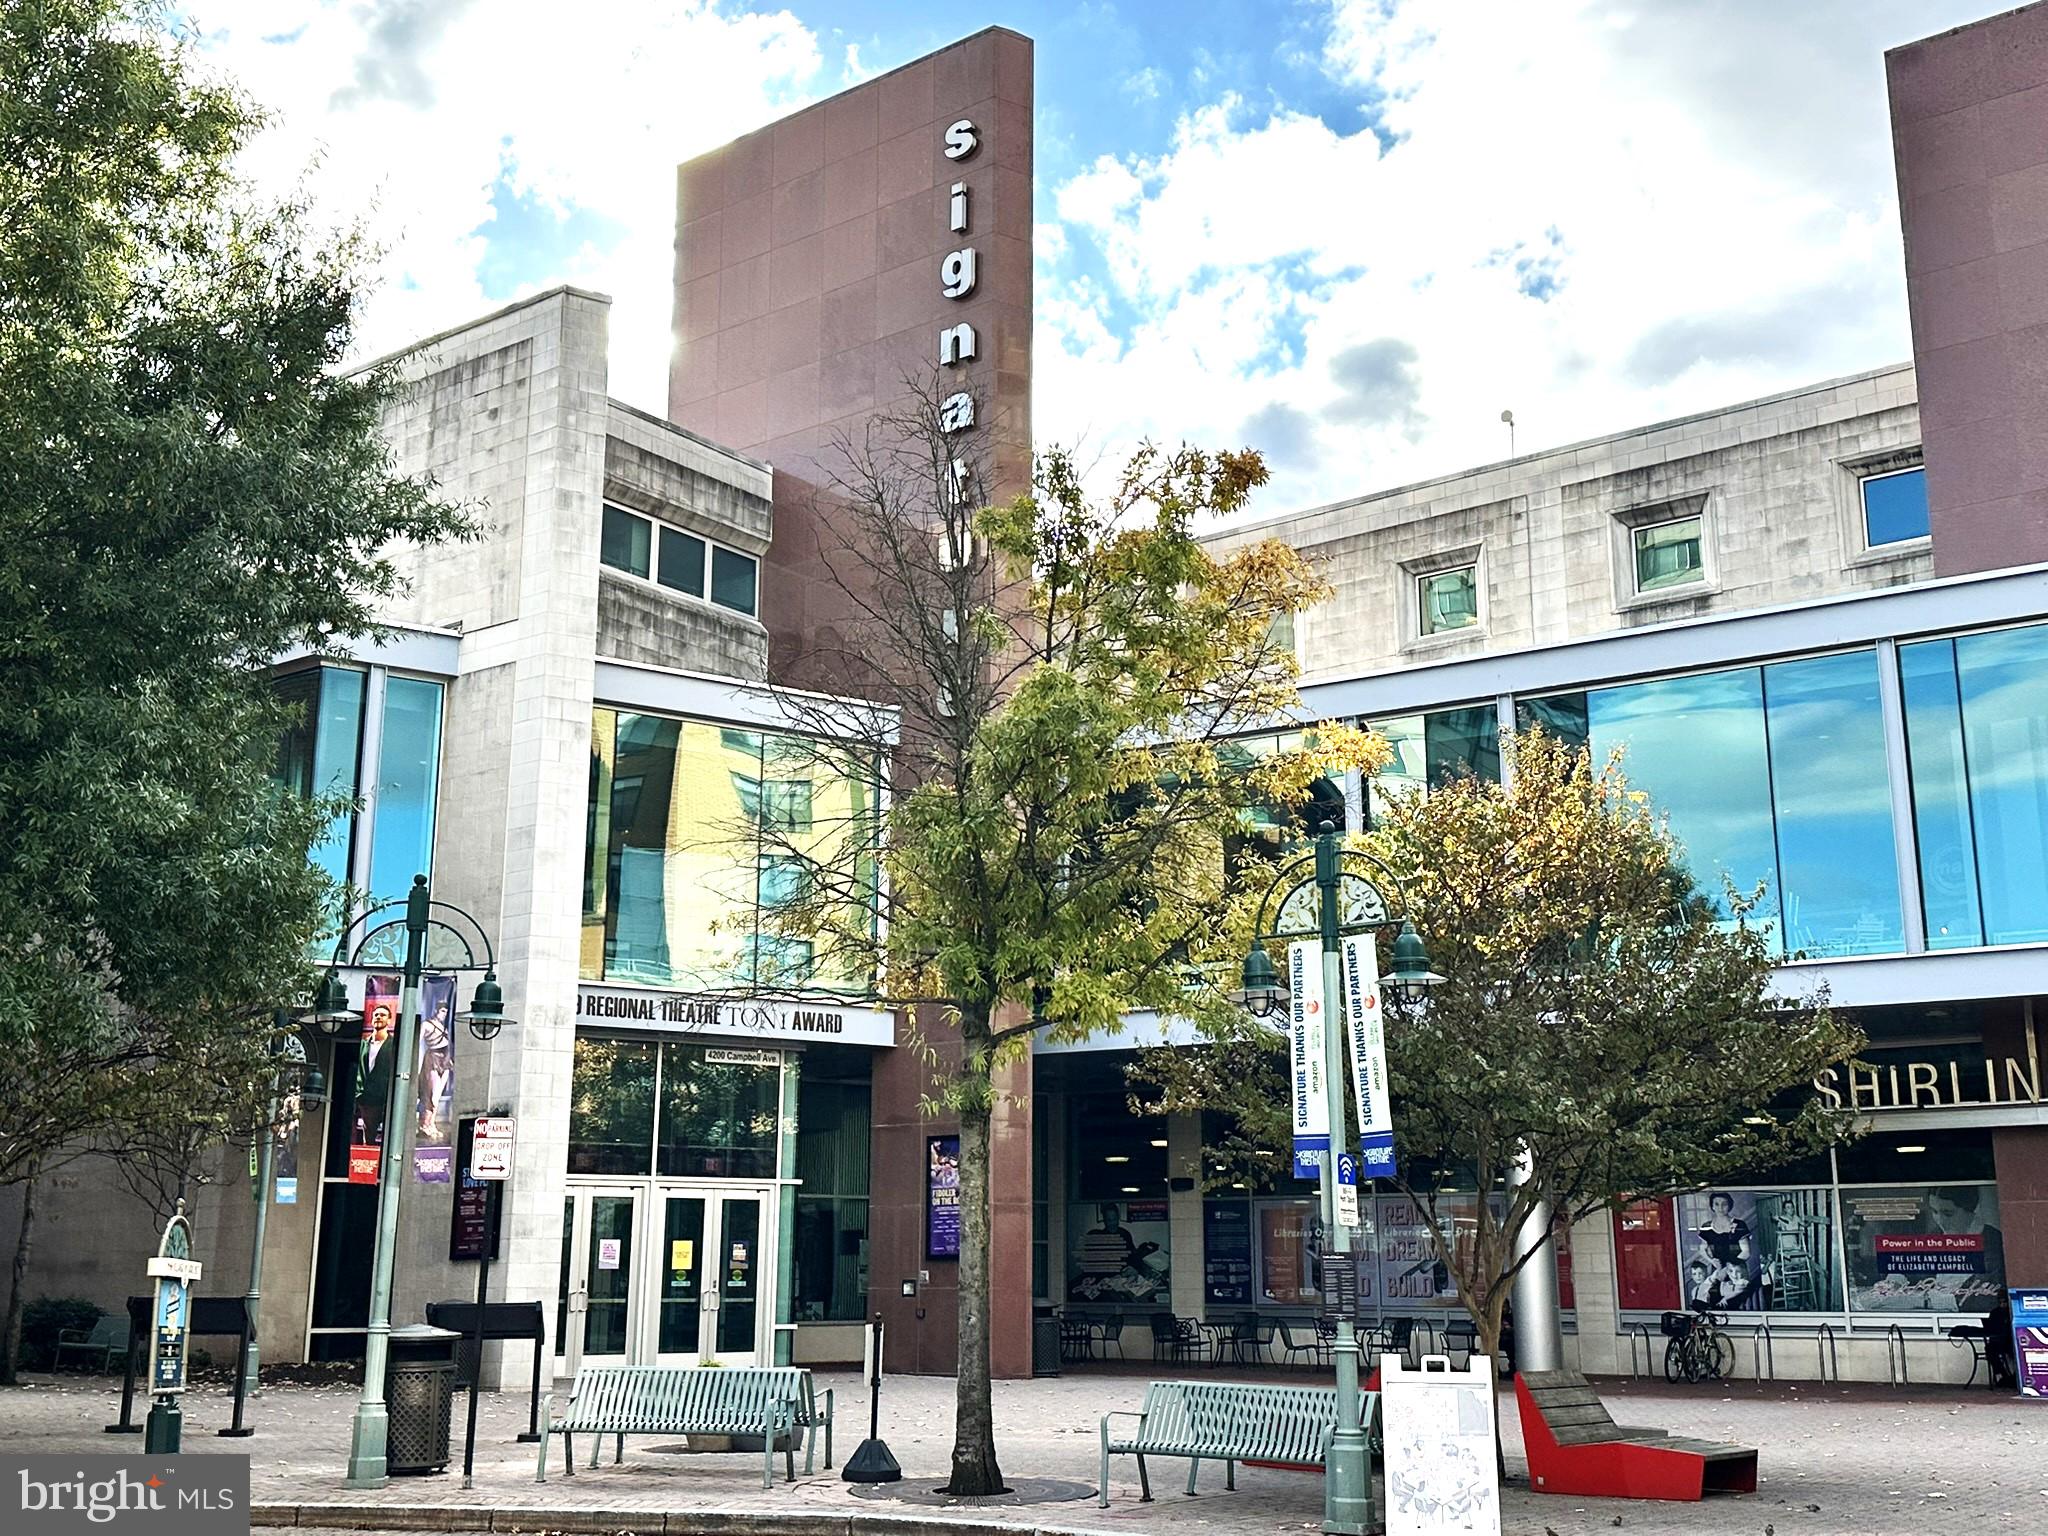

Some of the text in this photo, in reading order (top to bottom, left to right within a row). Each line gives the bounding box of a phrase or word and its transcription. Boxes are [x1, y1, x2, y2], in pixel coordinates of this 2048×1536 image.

[586, 995, 656, 1021] REGIONAL
[661, 999, 721, 1025] THEATRE
[792, 1010, 843, 1033] AWARD
[1293, 947, 1307, 1128] SIGNATURE THANKS OUR PARTNERS
[1347, 942, 1372, 1126] SIGNATURE THANKS OUR PARTNERS
[707, 1050, 726, 1060] 4200
[727, 1051, 761, 1063] Campbell
[1372, 1056, 1381, 1091] amazon
[476, 1122, 513, 1135] NO PARKING
[476, 1142, 510, 1150] DROP OFF
[483, 1153, 503, 1162] ZONE
[1882, 1237, 1976, 1248] Power in the Public
[1386, 1241, 1440, 1261] DREAM
[1891, 1255, 1967, 1263] THE LIFE AND LEGACY
[1887, 1263, 1975, 1271] OF ELIZABETH CAMPBELL
[1387, 1275, 1434, 1298] BUILD
